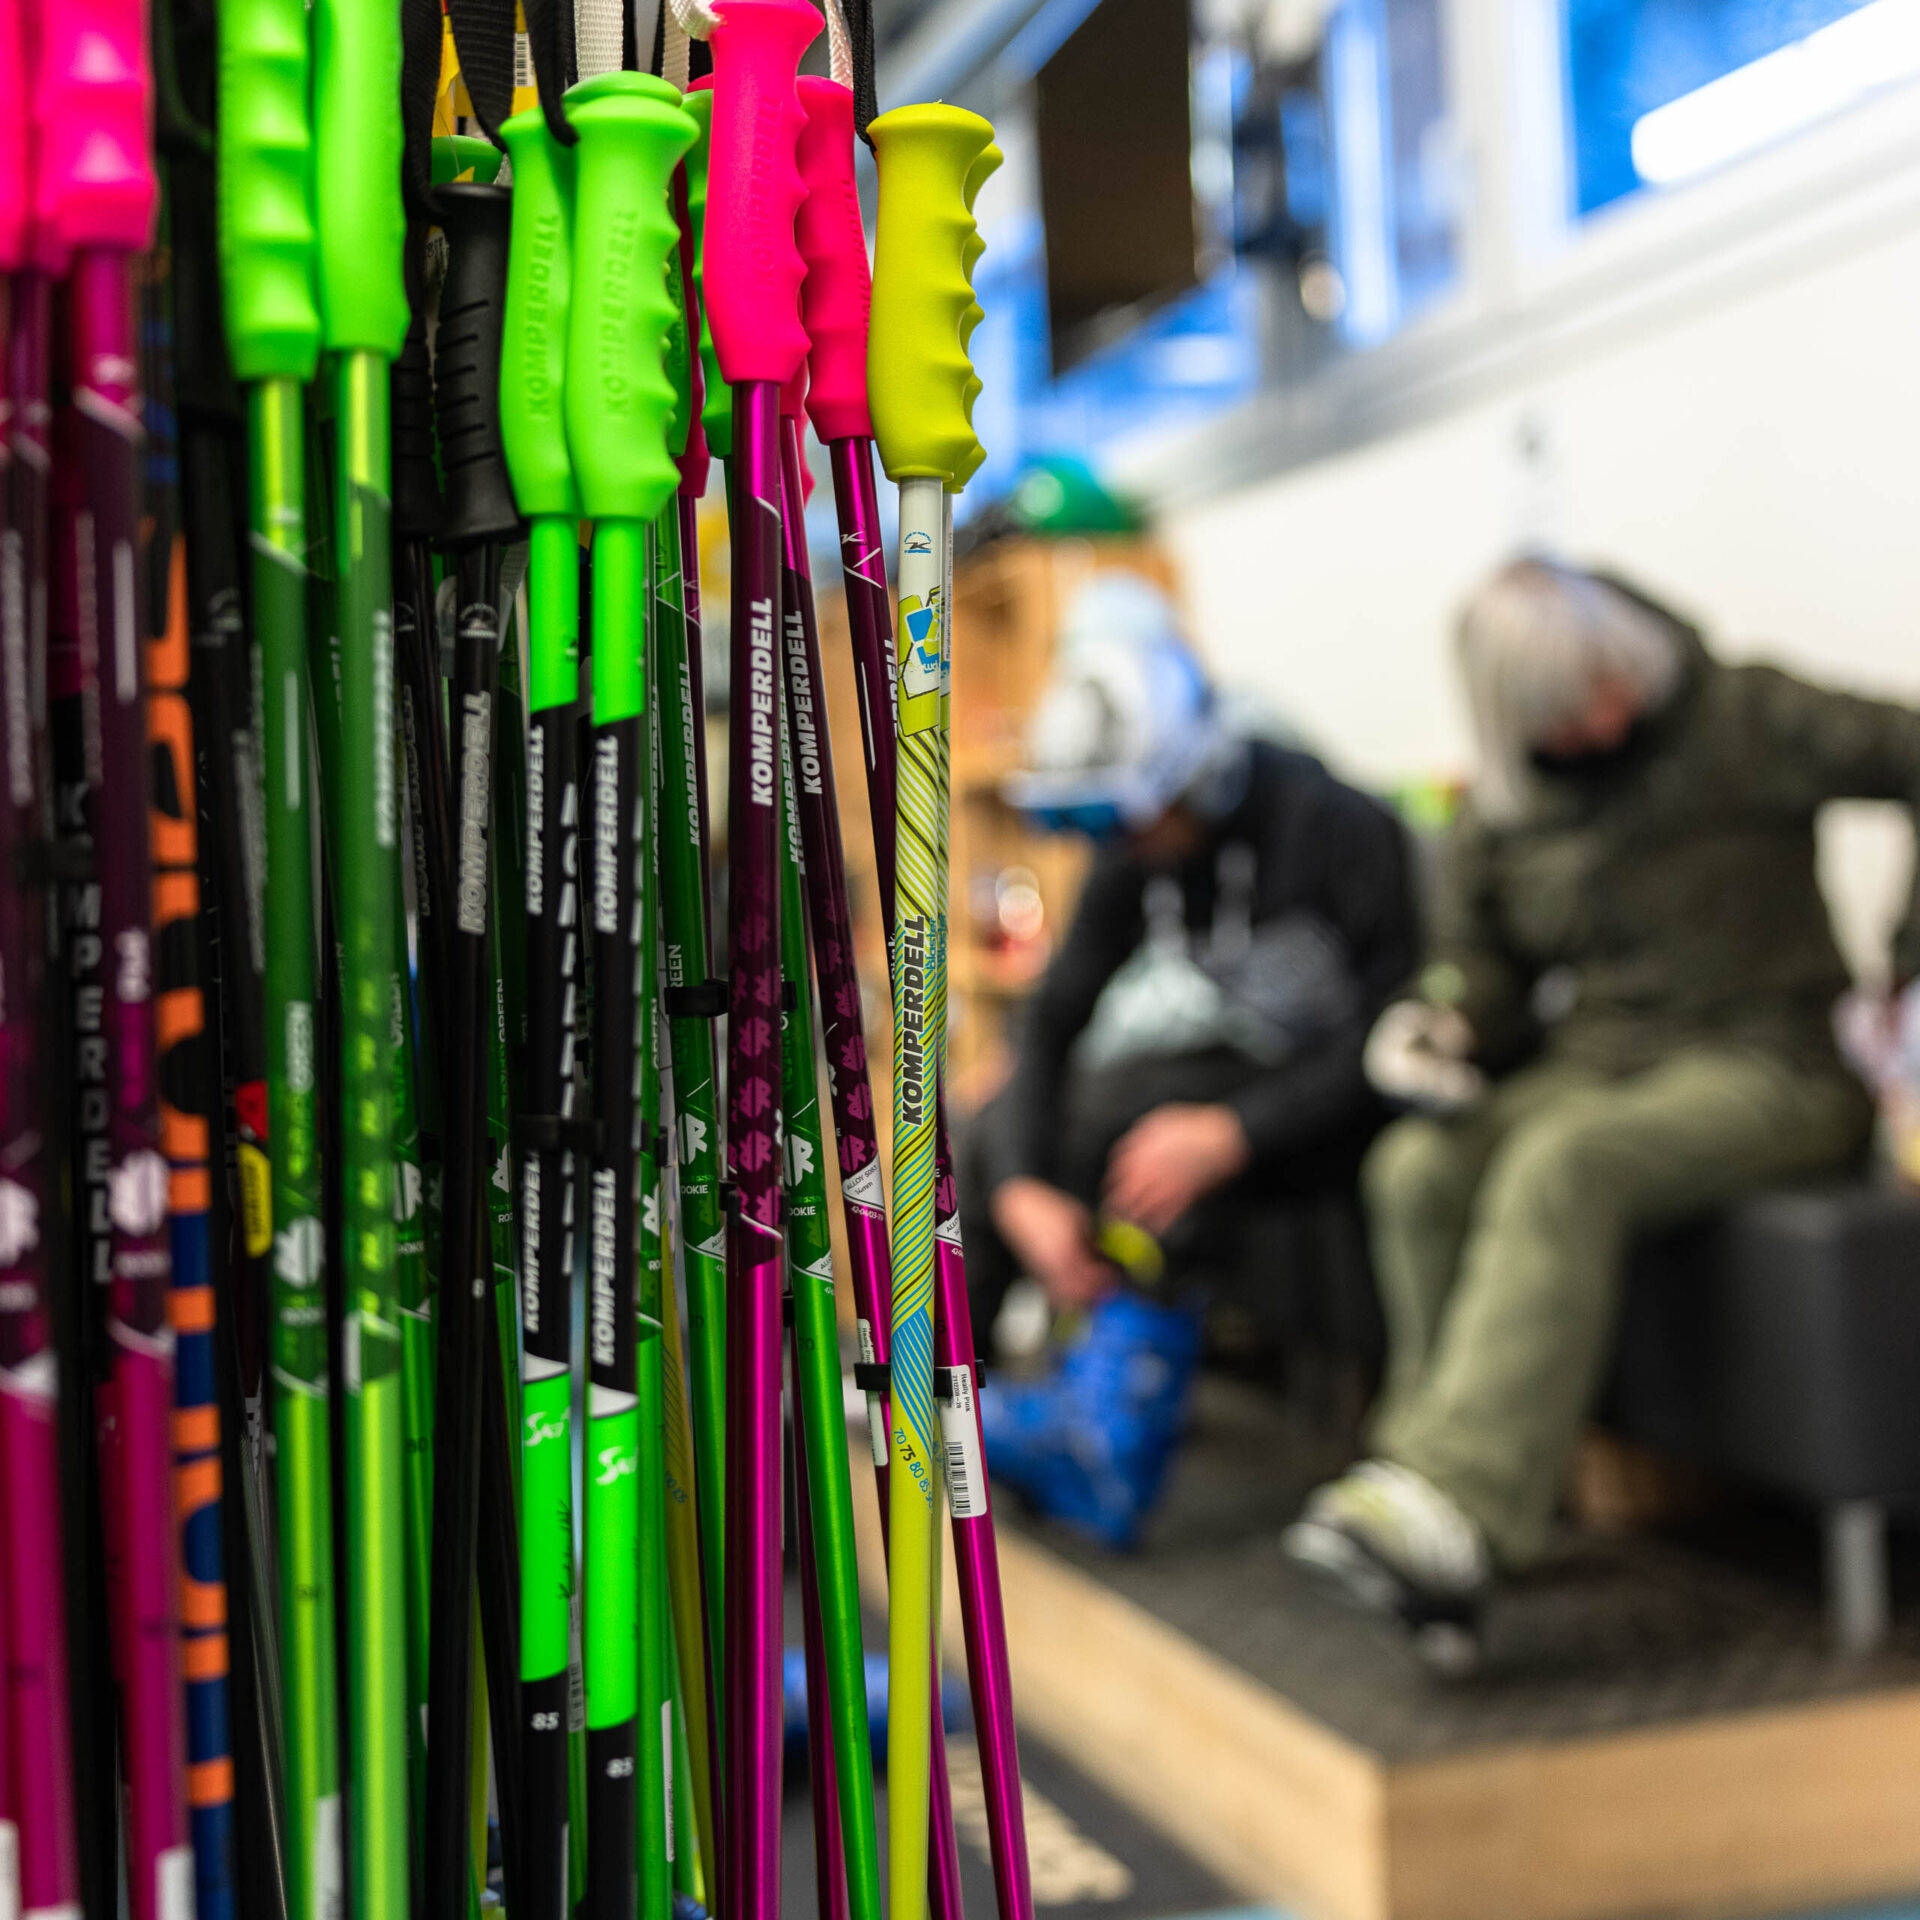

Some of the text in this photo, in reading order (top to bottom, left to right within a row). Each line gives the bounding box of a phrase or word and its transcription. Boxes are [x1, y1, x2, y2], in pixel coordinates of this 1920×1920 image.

[527, 213, 558, 418] KOMPERDELL
[680, 662, 698, 848] KOMPERDELL
[750, 598, 774, 807] KOMPERDELL
[784, 610, 823, 795] KOMPERDELL
[458, 690, 491, 935] KOMPERDELL
[526, 724, 545, 915] KOMPERDELL
[595, 735, 619, 932] KOMPERDELL
[60, 780, 113, 1284] KMPERDELL
[901, 913, 925, 1127] KOMPERDELL
[926, 916, 937, 970] blaster
[523, 1152, 542, 1334] KOMPERDEL
[592, 1166, 617, 1368] KOMPERDELL
[894, 1427, 907, 1445] 70
[900, 1444, 917, 1462] 75
[909, 1461, 925, 1479] 80
[961, 1373, 969, 1395] Really
[918, 1478, 931, 1493] 85
[531, 1712, 560, 1730] 85
[606, 1757, 634, 1778] 85
